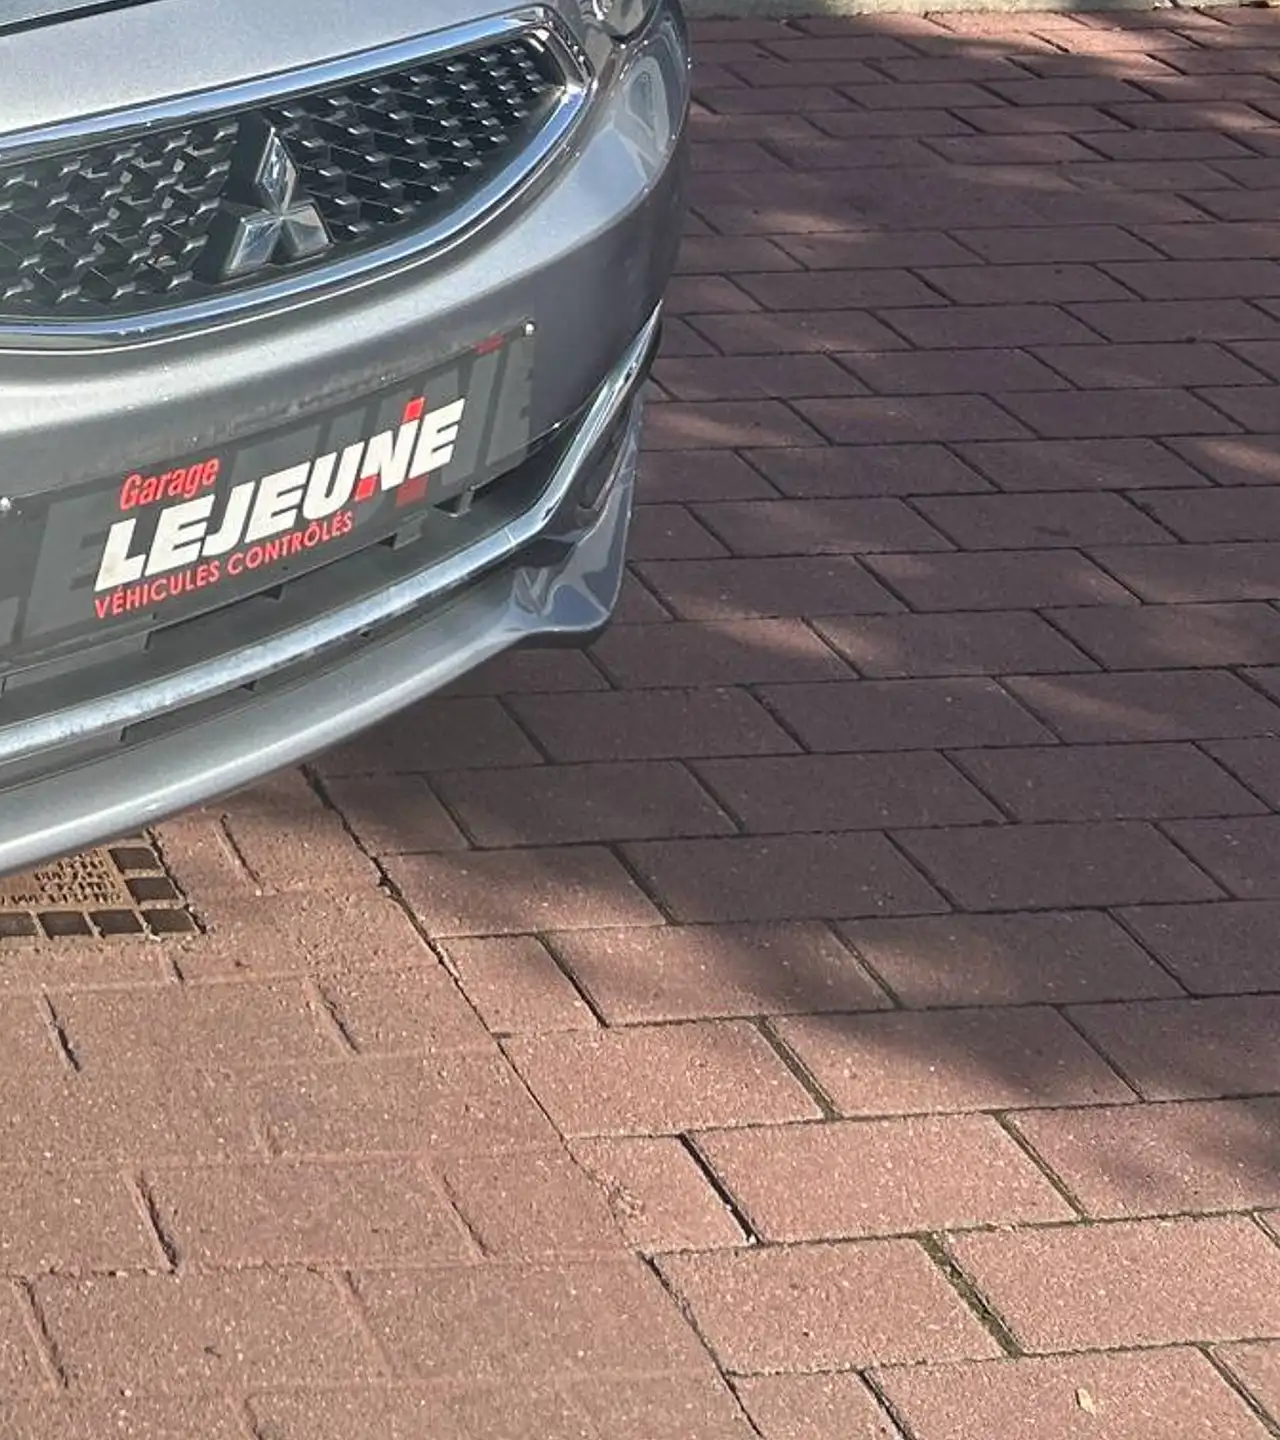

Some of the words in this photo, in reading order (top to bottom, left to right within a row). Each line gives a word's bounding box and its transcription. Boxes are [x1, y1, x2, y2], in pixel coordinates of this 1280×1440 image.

[94, 397, 466, 591] LEJEUNE
[119, 457, 220, 511] Garage
[94, 559, 220, 619] VÉHICULES
[227, 510, 353, 576] CONTRÔLÉS
